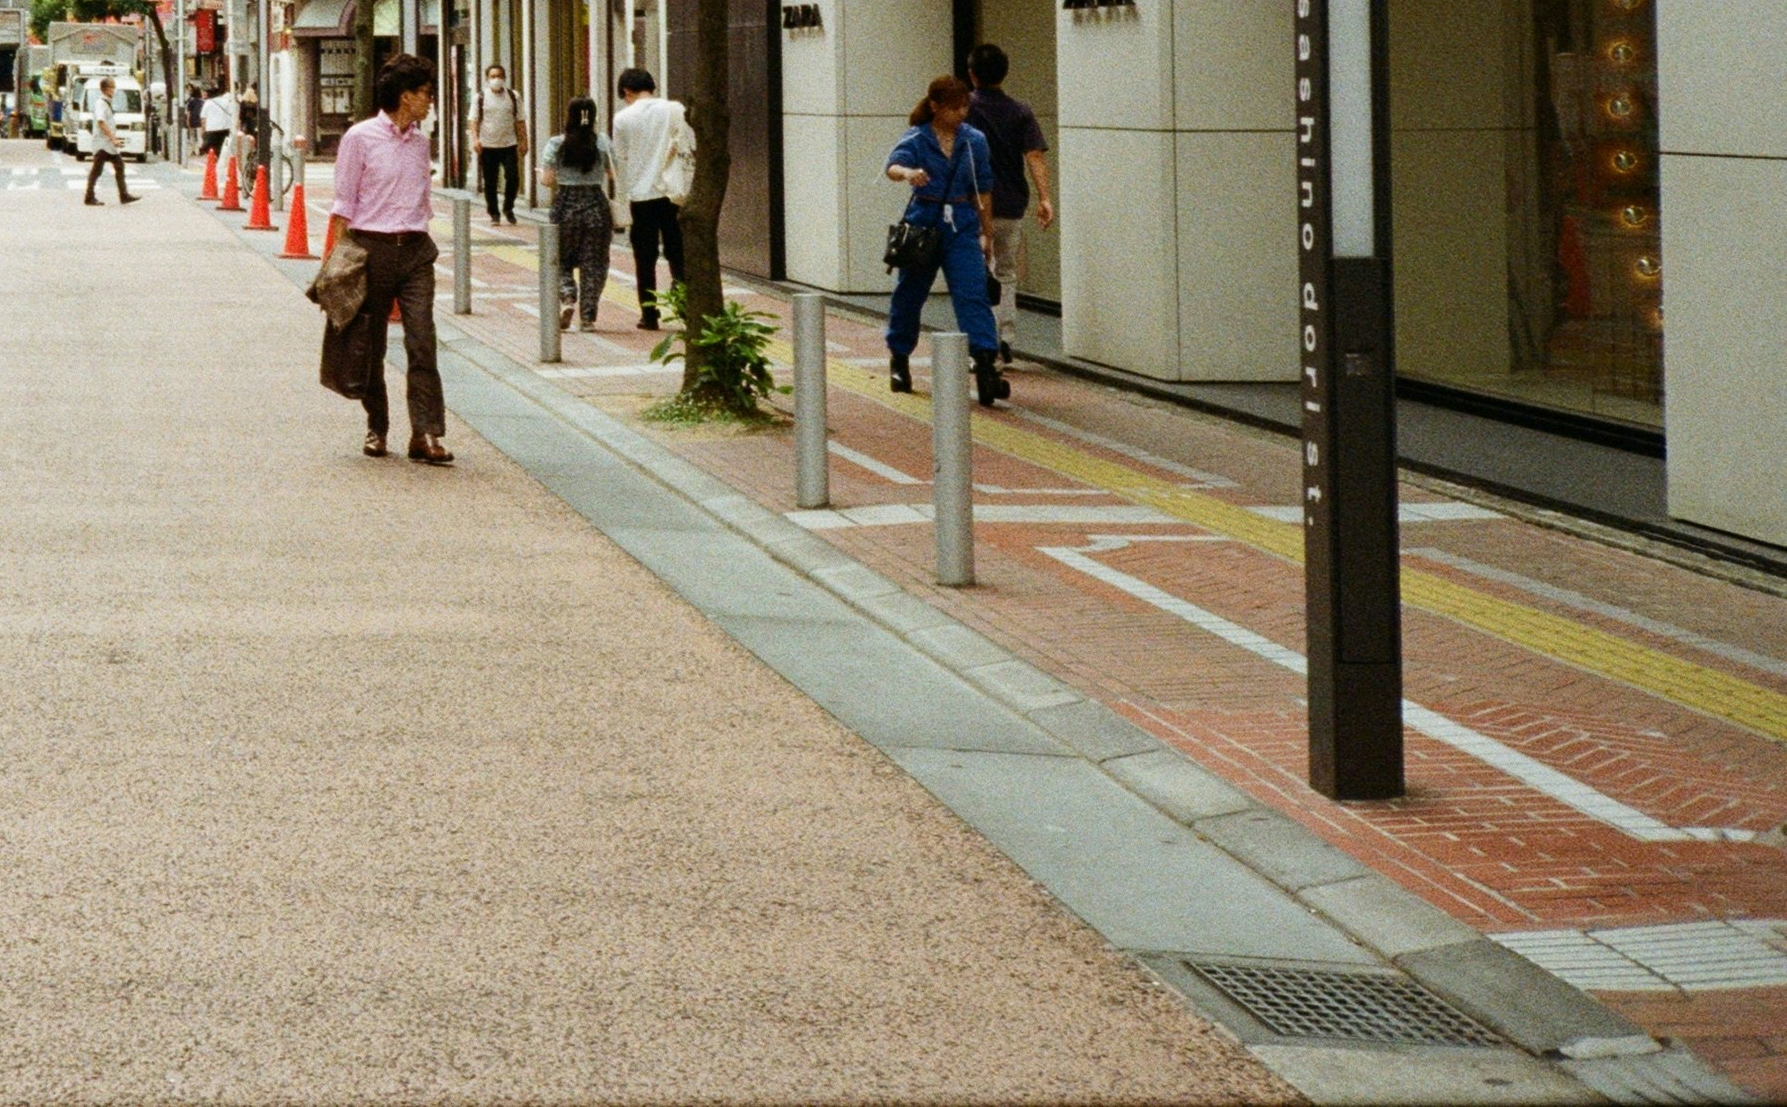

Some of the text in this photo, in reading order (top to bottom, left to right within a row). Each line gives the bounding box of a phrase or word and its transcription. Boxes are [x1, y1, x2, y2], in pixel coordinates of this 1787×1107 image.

[782, 3, 823, 29] ZARA
[1303, 283, 1319, 414] dori
[1306, 441, 1321, 526] st.
